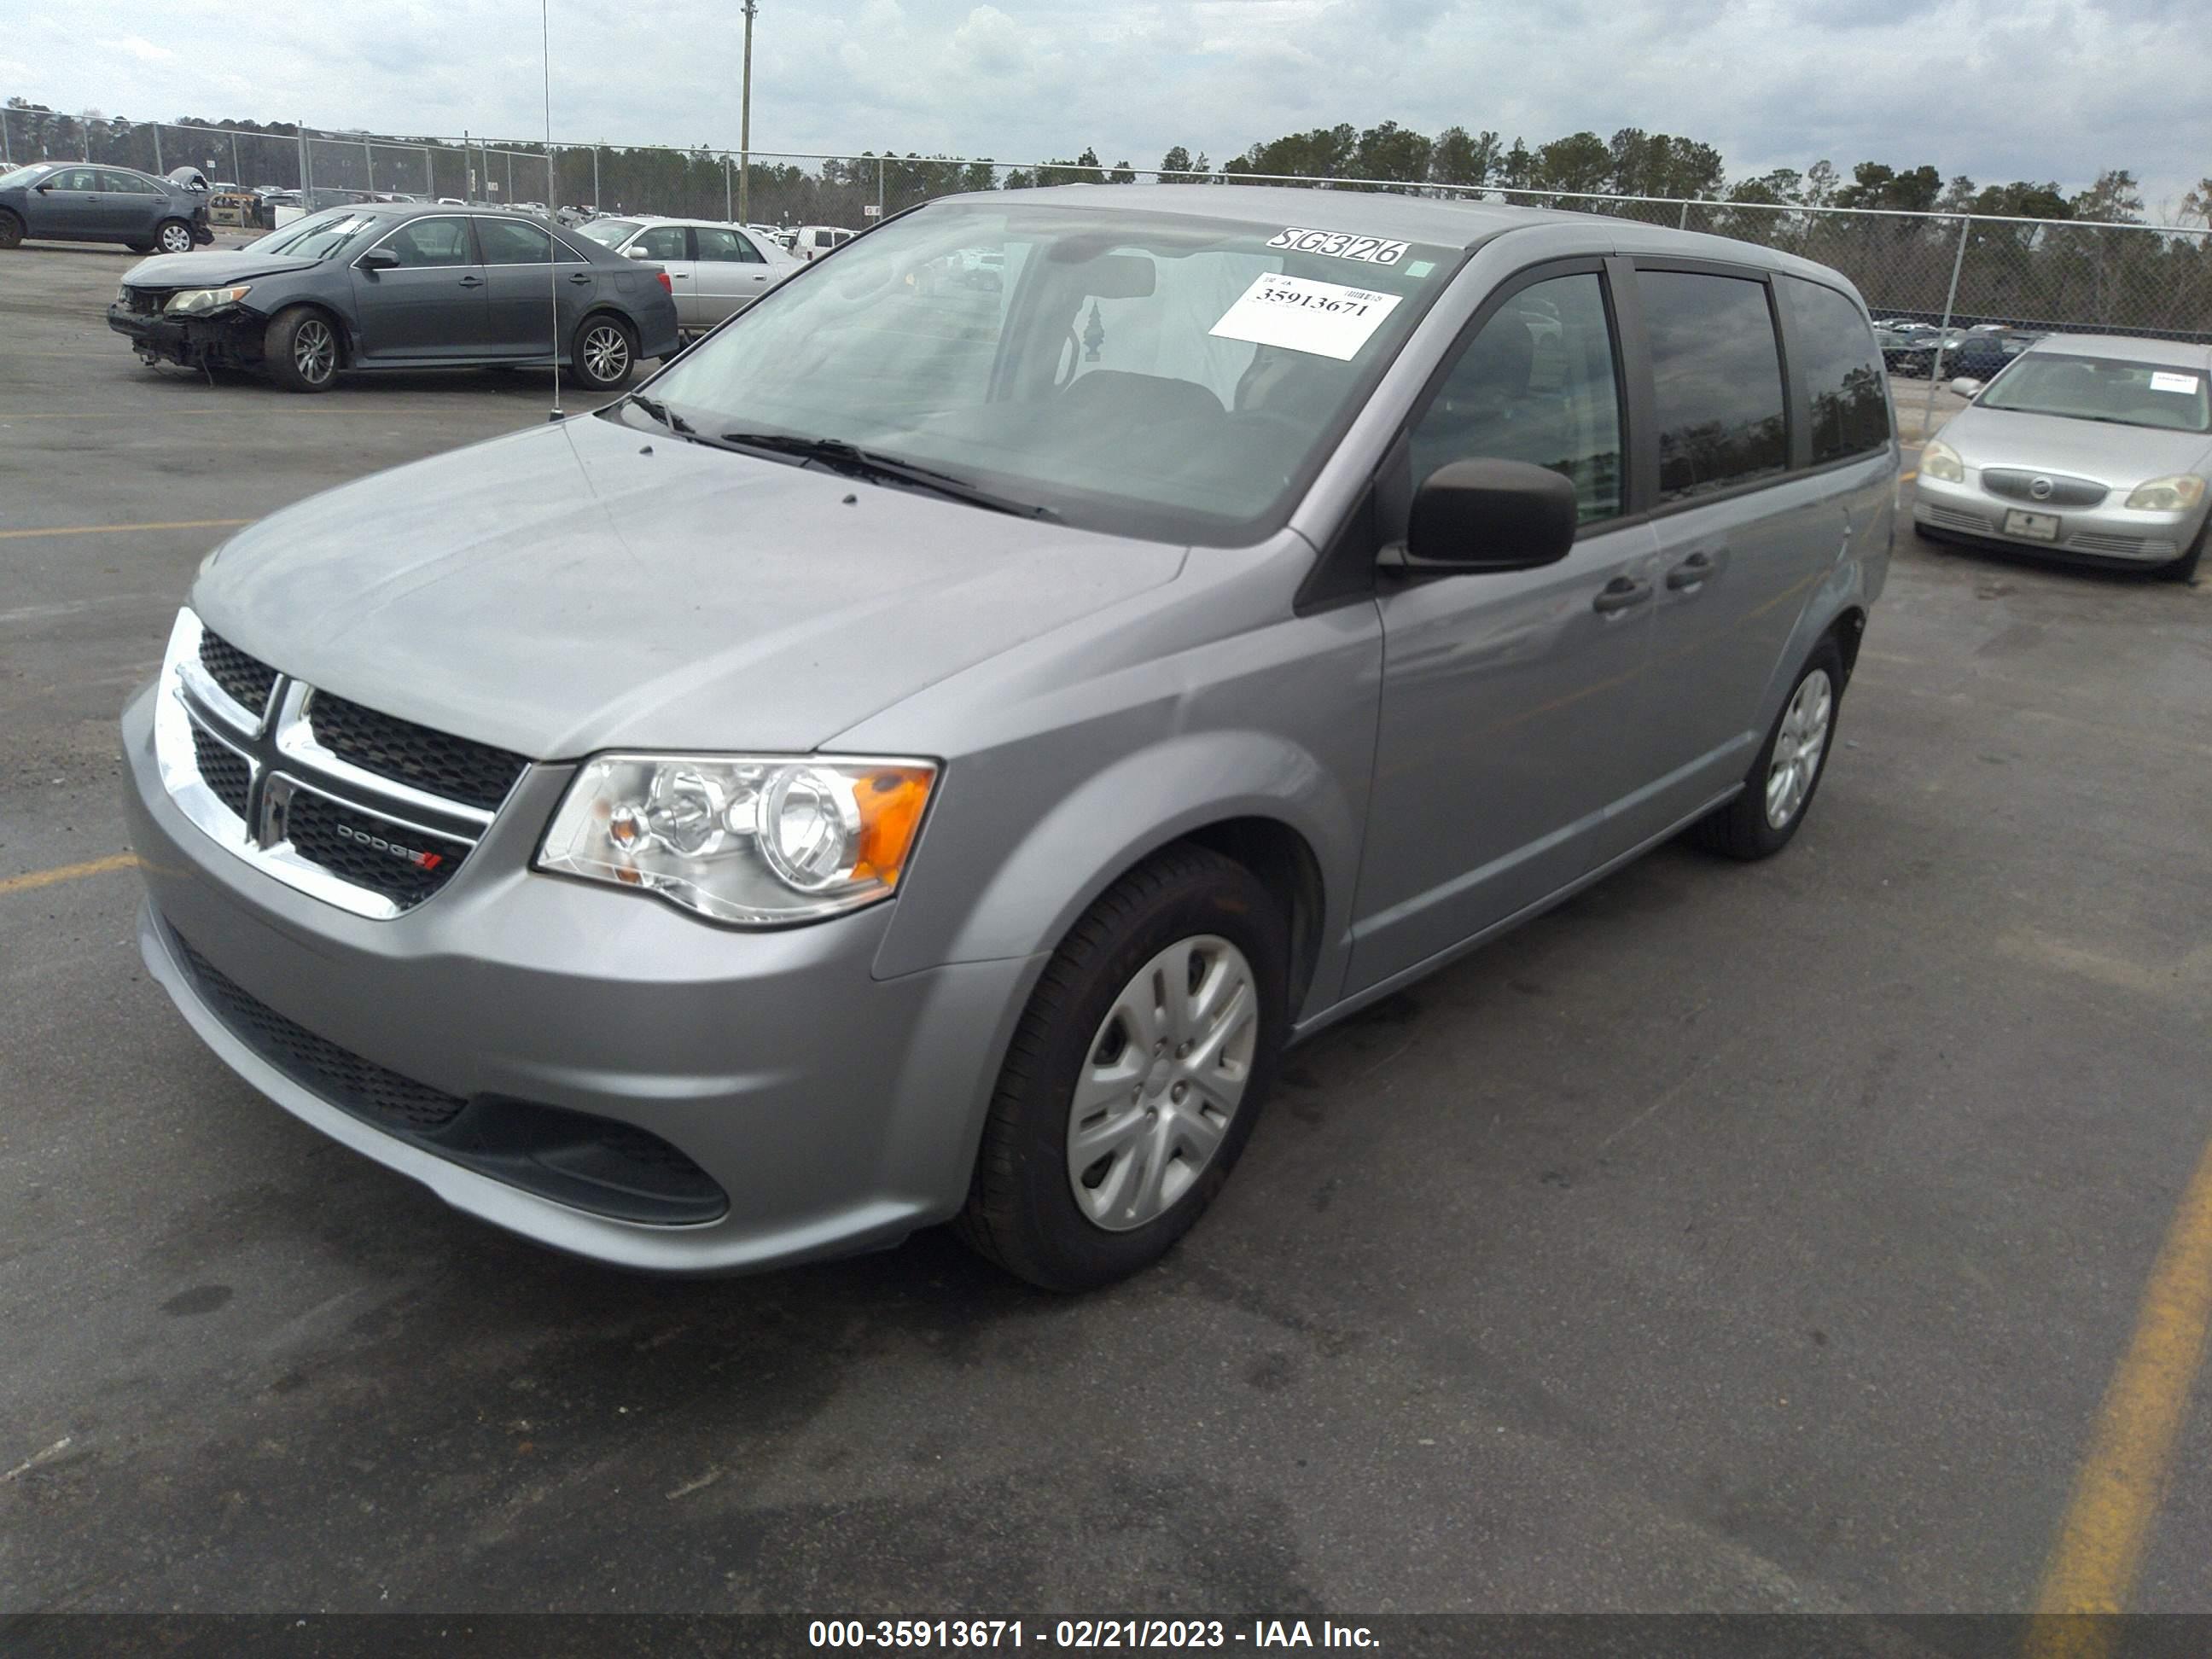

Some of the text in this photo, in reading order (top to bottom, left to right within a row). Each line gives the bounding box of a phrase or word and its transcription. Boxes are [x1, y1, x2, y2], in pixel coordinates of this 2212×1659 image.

[1270, 229, 1400, 265] SG326
[1256, 288, 1369, 317] 35913671
[337, 824, 426, 865] DODGE
